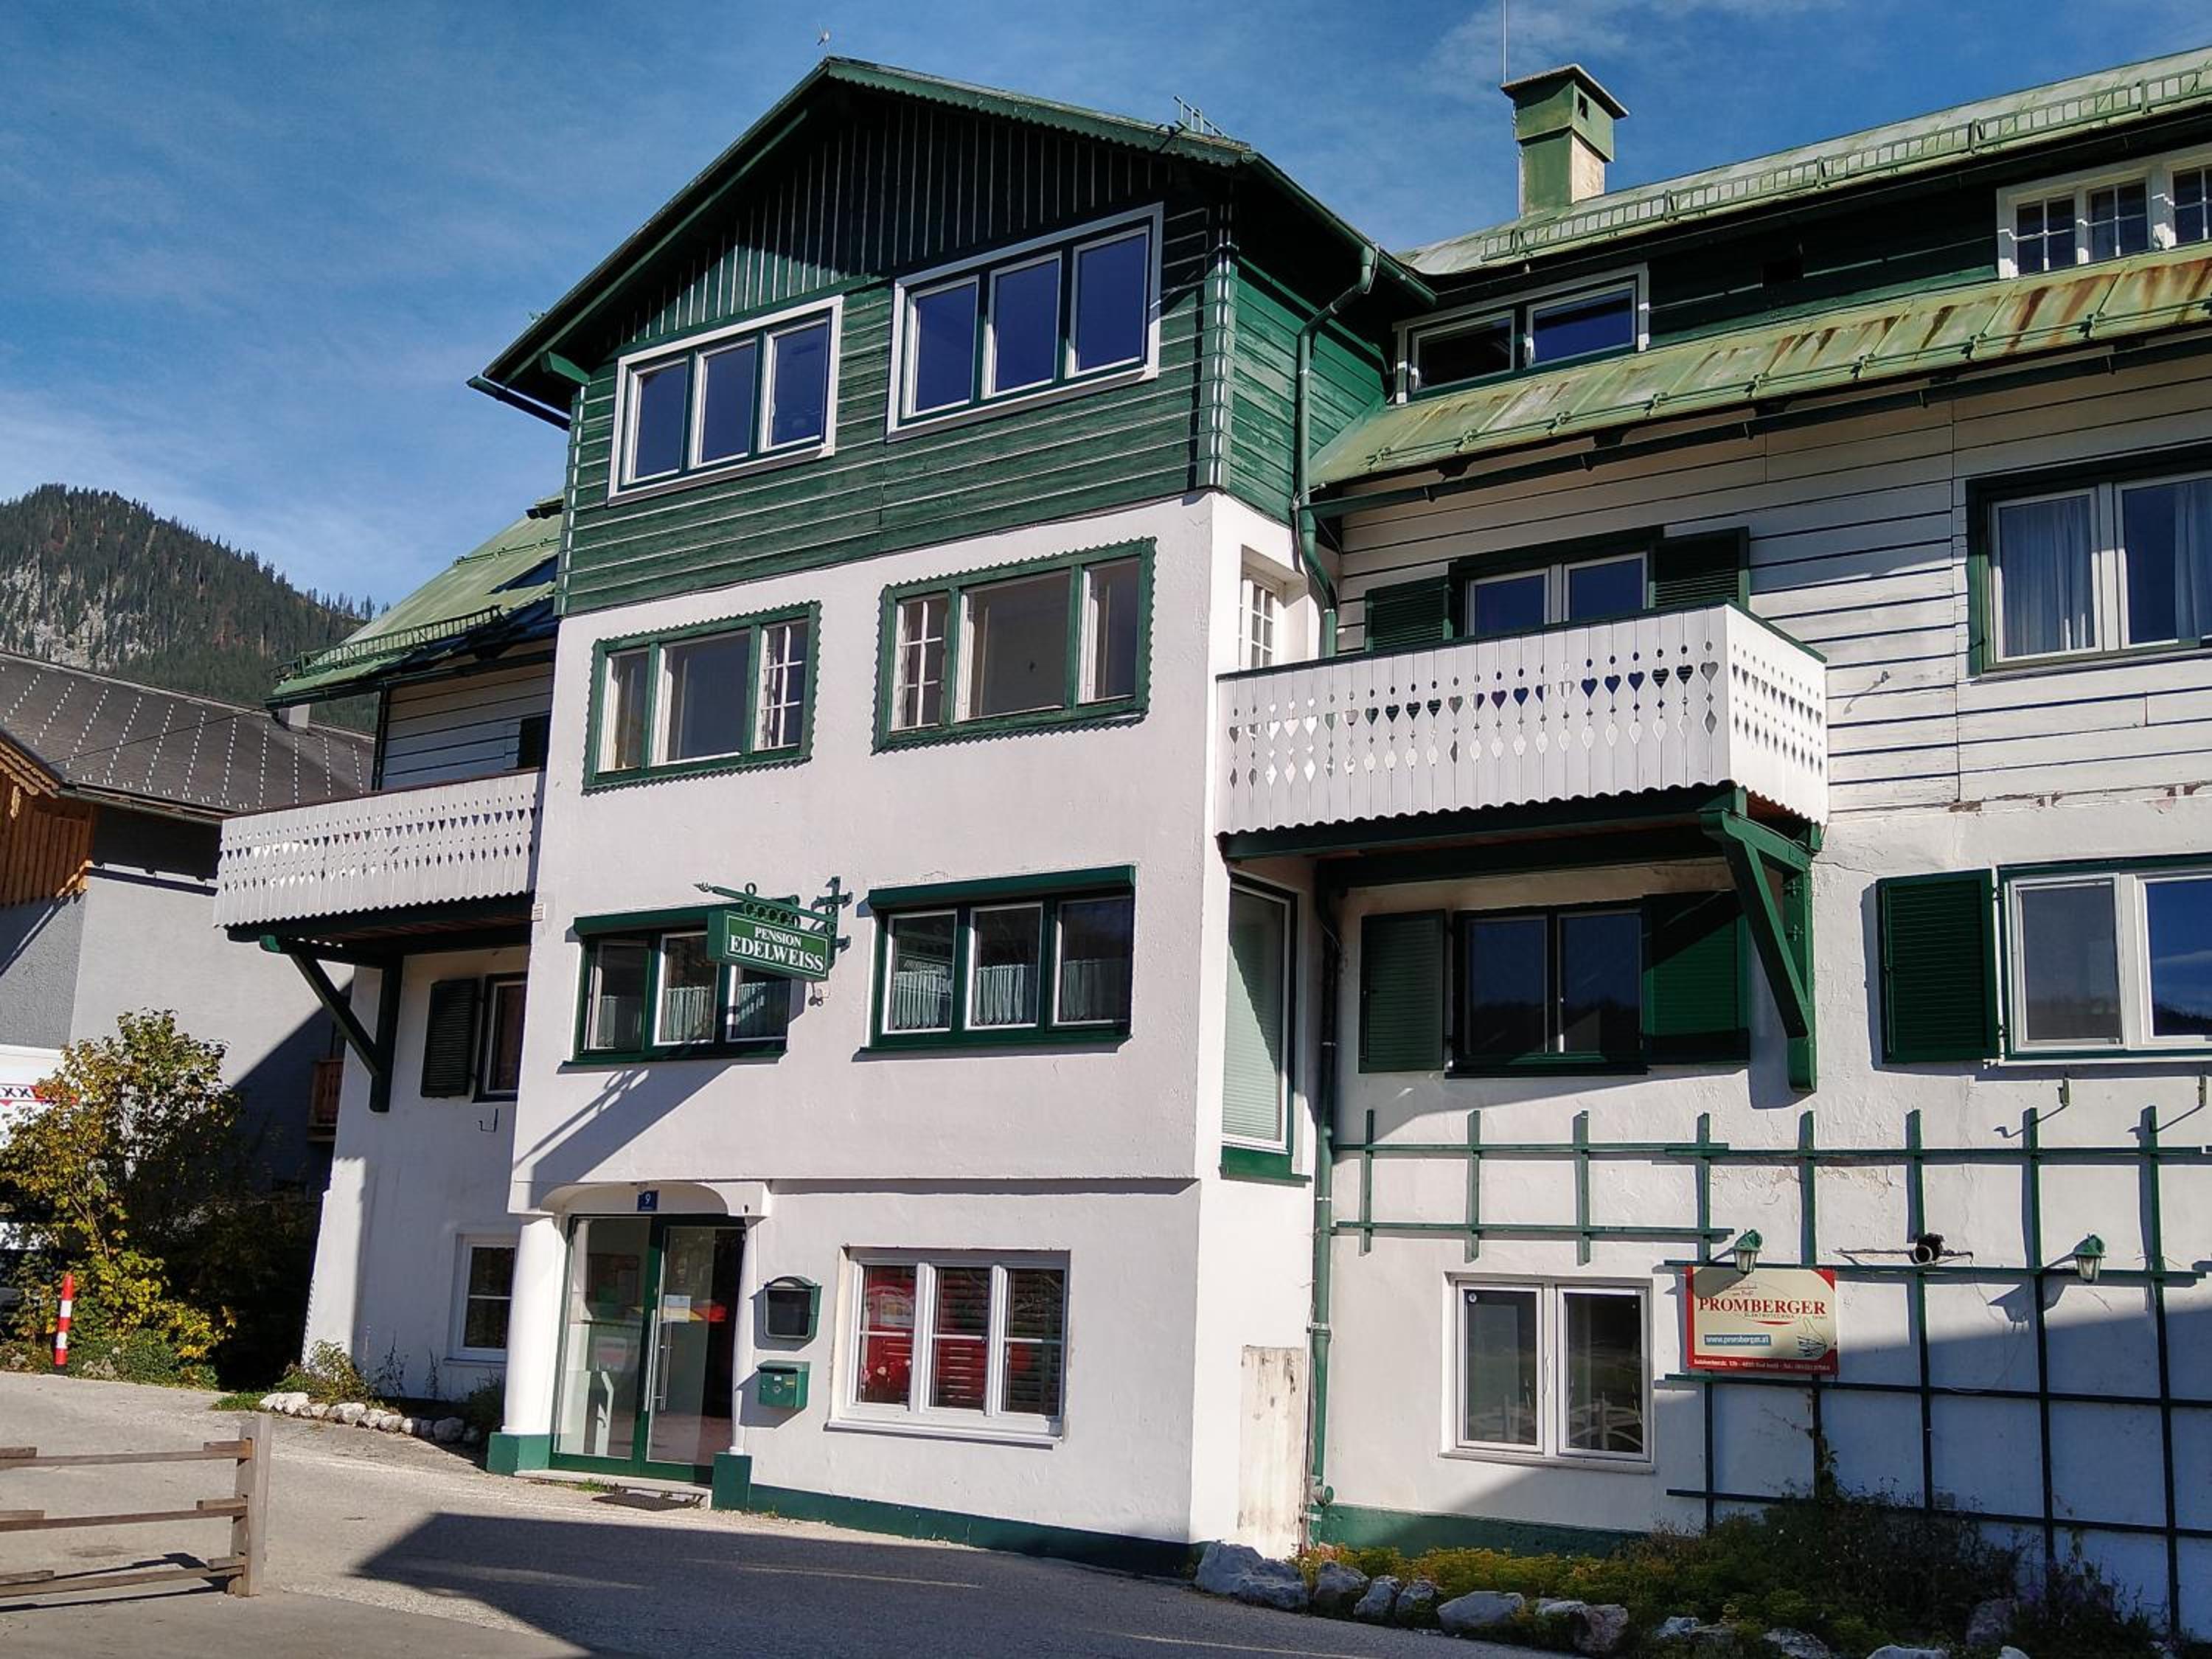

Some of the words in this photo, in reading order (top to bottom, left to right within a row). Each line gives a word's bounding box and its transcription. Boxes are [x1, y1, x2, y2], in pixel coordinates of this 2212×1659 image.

[755, 927, 801, 947] PENSION
[730, 936, 824, 971] EDELWEISS
[645, 1193, 651, 1204] 9
[1698, 1297, 1826, 1315] PROMBERGER
